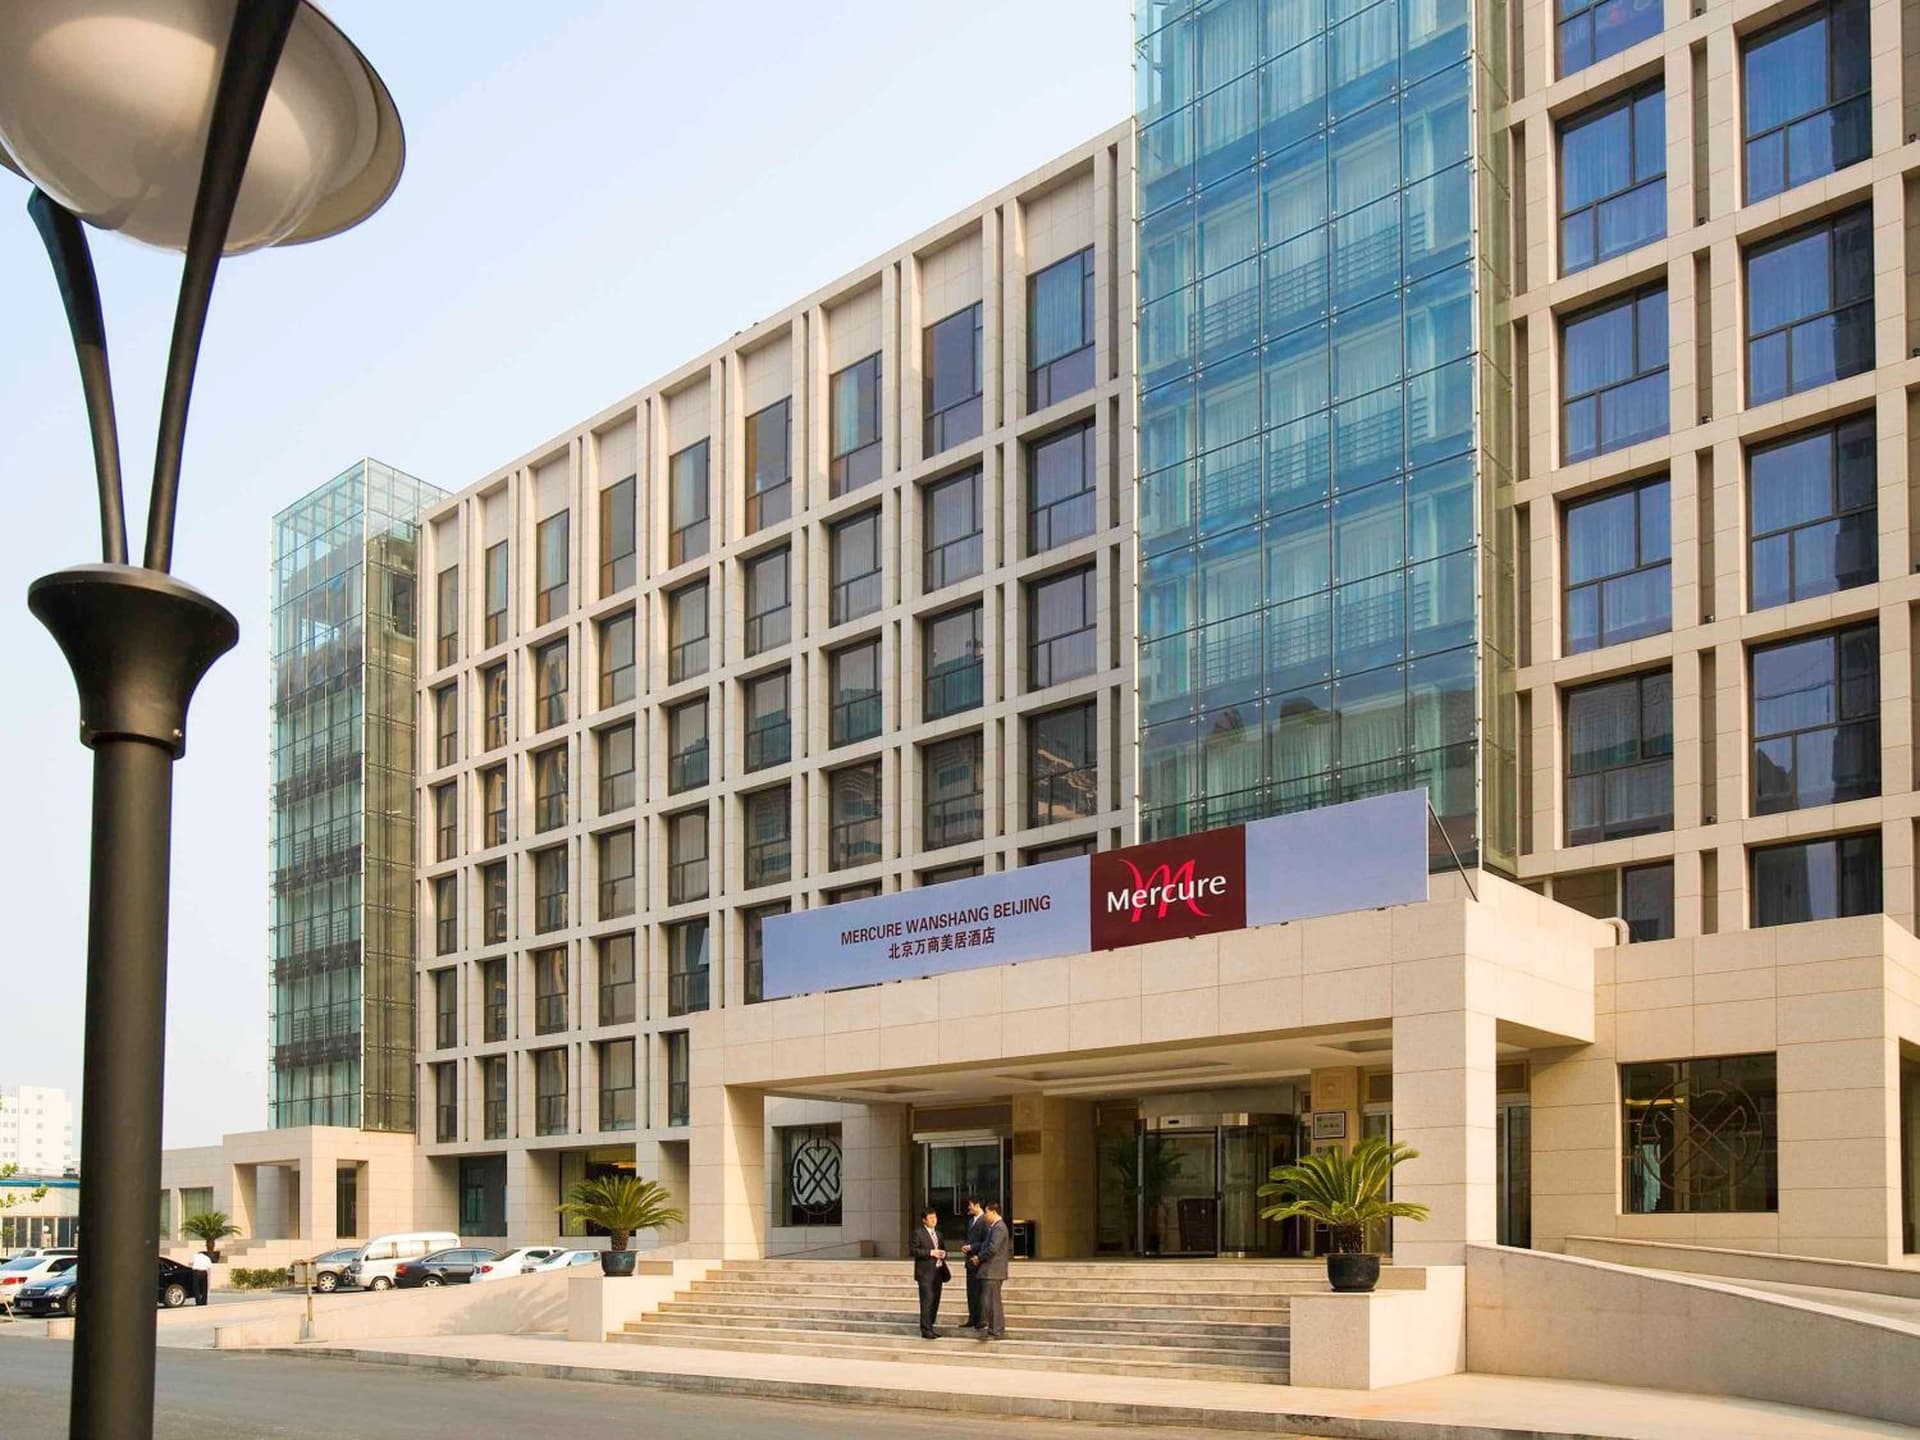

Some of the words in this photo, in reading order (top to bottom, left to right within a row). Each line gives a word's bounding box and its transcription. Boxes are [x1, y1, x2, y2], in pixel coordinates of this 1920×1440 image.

[1107, 875, 1226, 913] Mercure
[841, 922, 902, 946] MERCURE
[906, 906, 989, 934] WANSHANG
[993, 895, 1051, 919] BEIJING
[888, 926, 996, 960] 北京万商美居酒店
